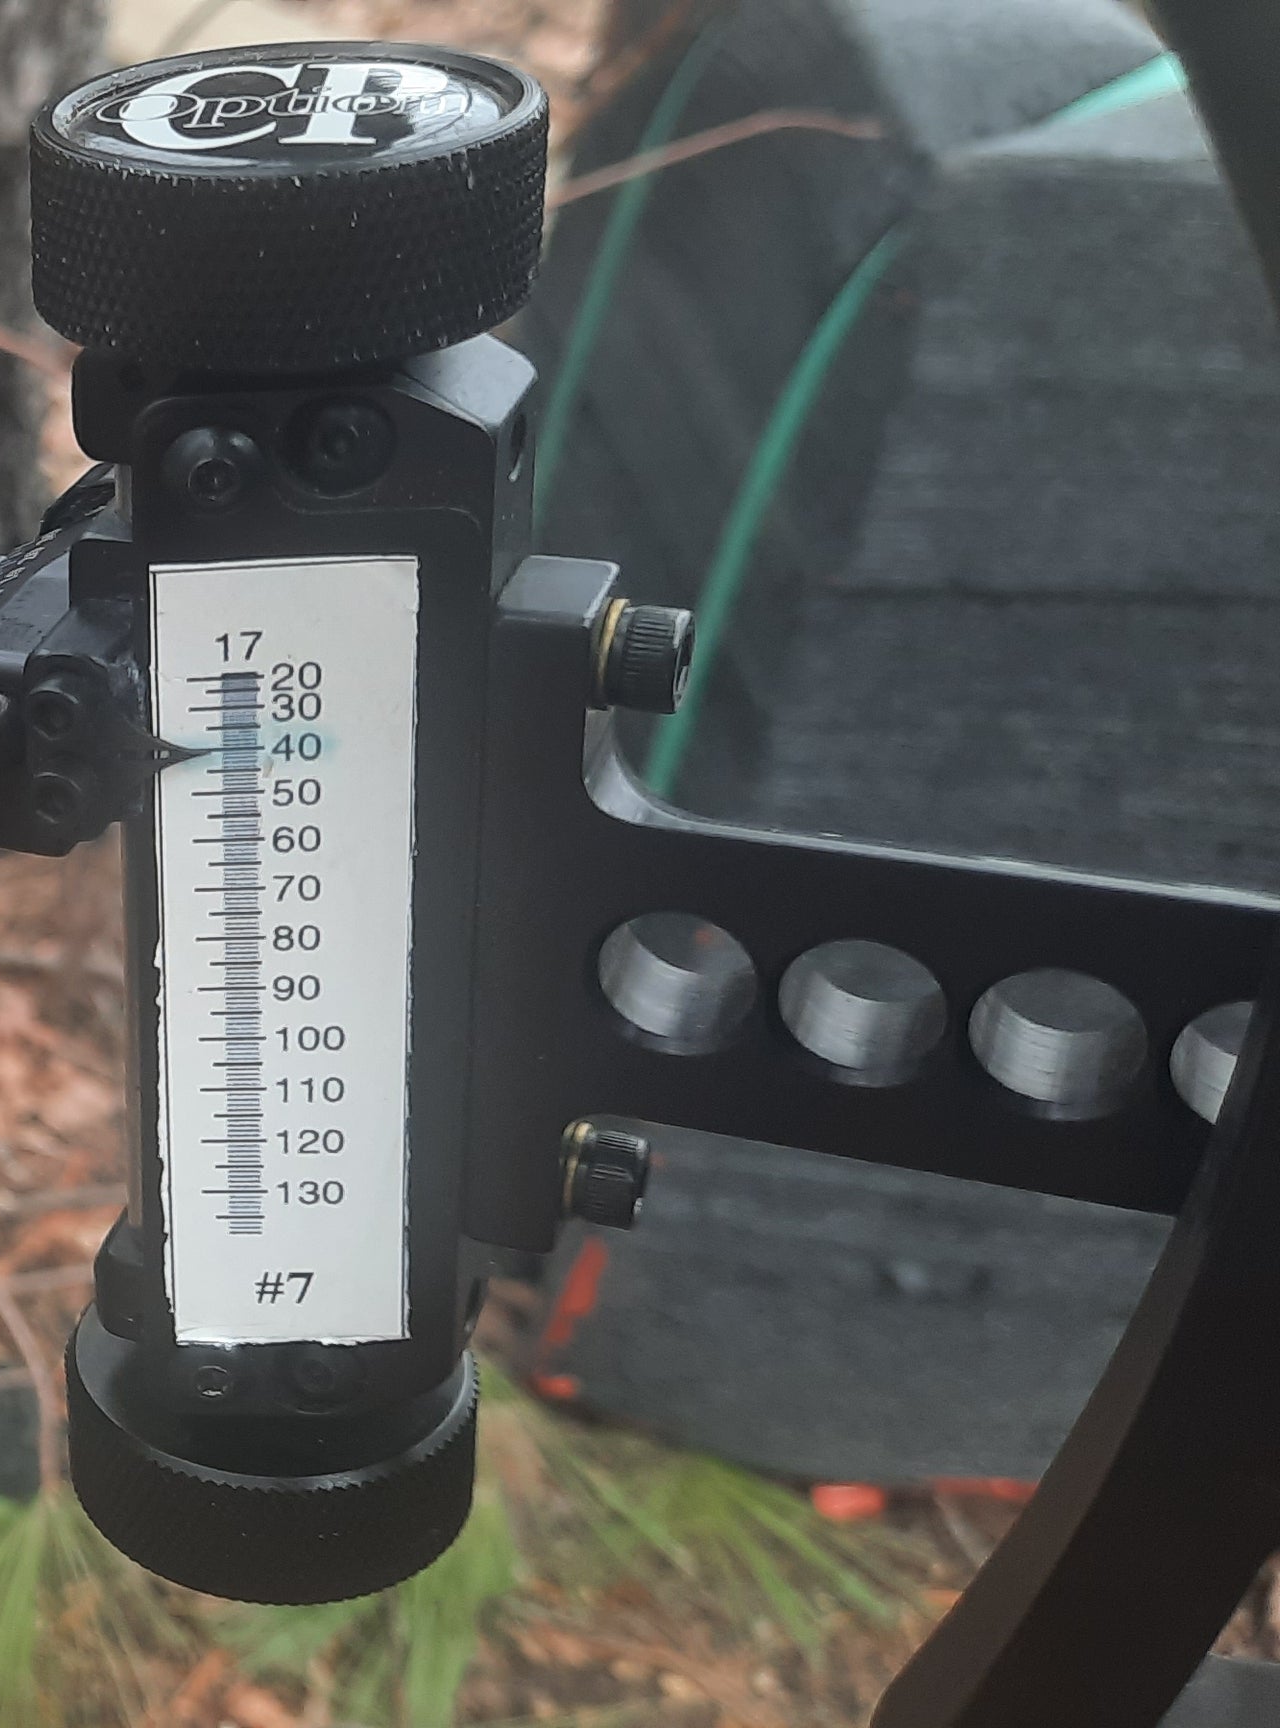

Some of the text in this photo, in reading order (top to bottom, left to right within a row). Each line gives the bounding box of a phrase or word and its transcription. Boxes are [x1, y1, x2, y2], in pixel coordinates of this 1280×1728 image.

[121, 63, 449, 150] CP
[214, 631, 264, 662] 17
[270, 661, 322, 691] 20
[271, 692, 322, 722] 30
[271, 732, 322, 761] 40
[272, 778, 322, 806] 50
[272, 825, 321, 853] 60
[272, 874, 321, 902] 70
[272, 925, 321, 951] 80
[272, 975, 321, 1001] 90
[274, 1025, 346, 1052] 100
[275, 1077, 345, 1103] 110
[276, 1129, 345, 1154] 120
[276, 1180, 345, 1205] 130
[254, 1271, 315, 1305] #7
